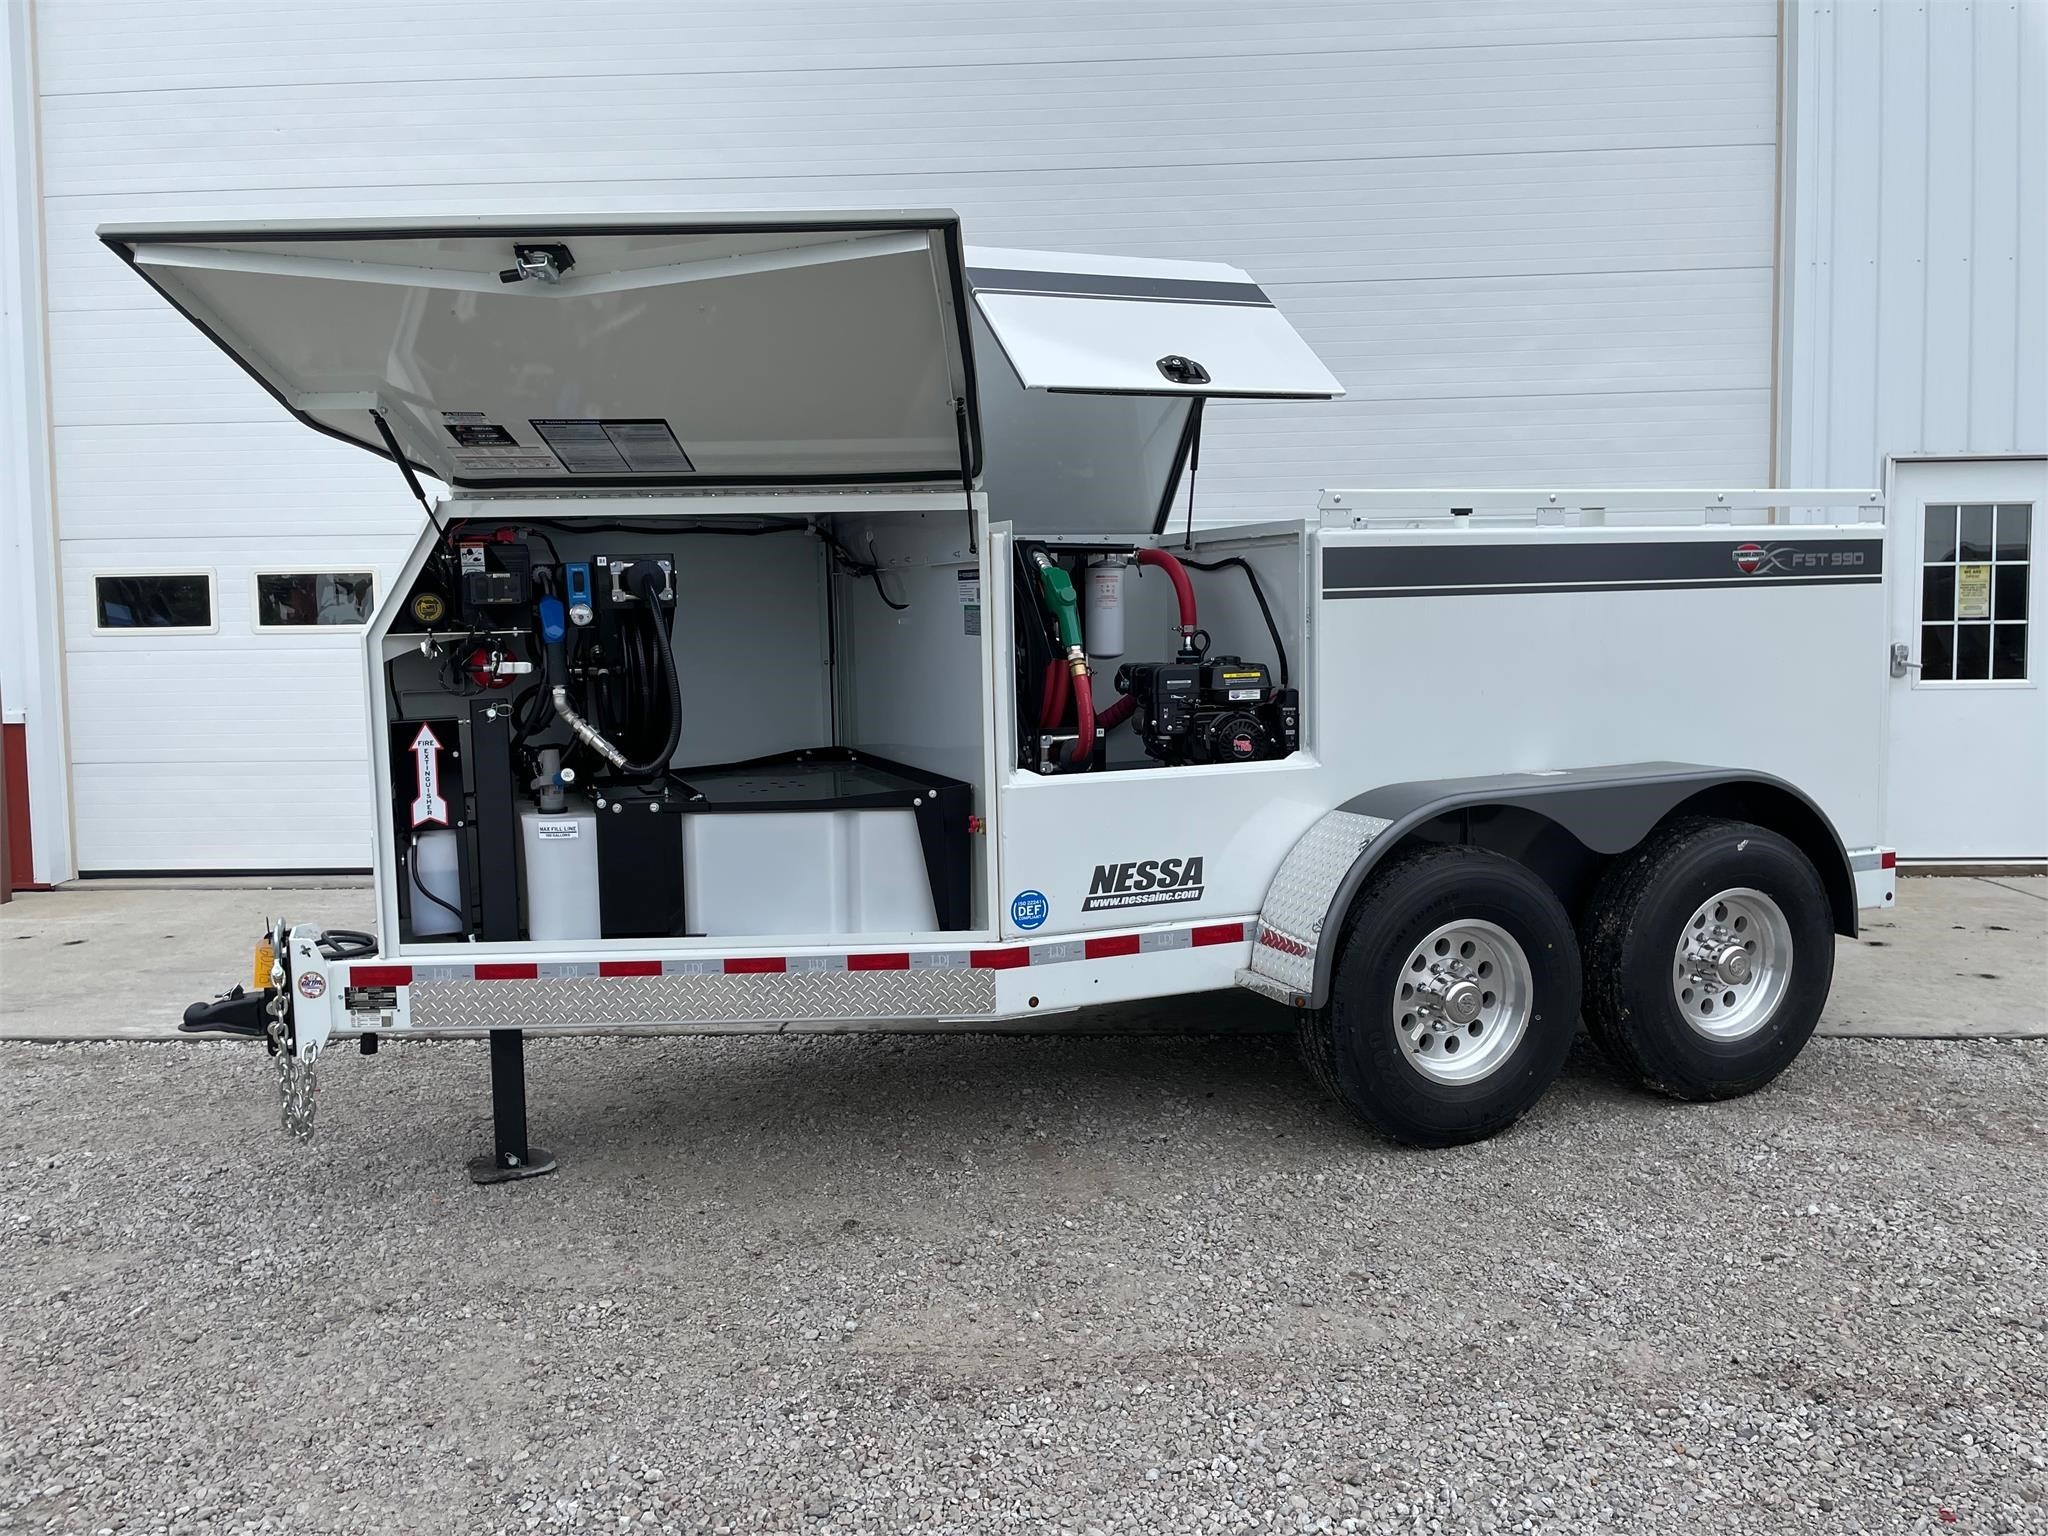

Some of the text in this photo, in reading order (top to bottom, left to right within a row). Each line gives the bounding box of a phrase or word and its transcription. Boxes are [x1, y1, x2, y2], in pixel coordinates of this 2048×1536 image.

[1792, 551, 1864, 567] FST 990
[424, 748, 432, 816] EXTINGUISHER
[1088, 856, 1204, 895] NESSA
[1090, 889, 1200, 909] www.nessainc.com
[1018, 904, 1042, 917] DEF
